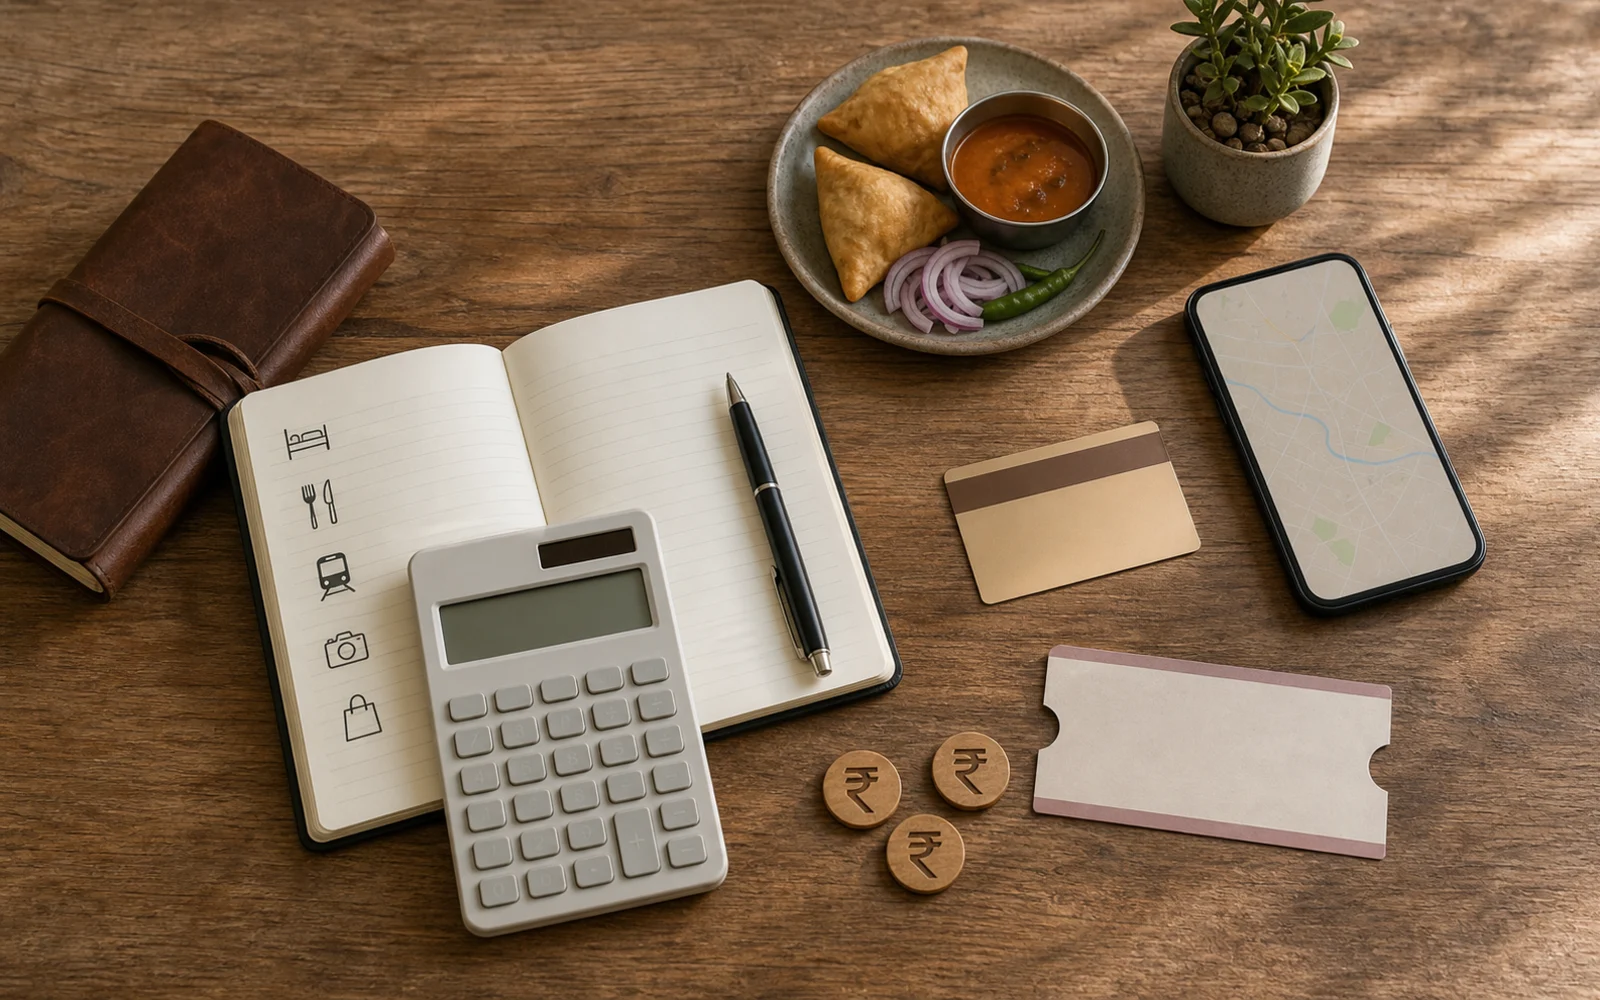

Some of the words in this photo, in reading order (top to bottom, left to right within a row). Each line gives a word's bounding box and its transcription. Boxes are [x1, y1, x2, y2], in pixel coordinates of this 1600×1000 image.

[843, 767, 879, 814] ₹
[953, 748, 988, 795] ₹
[907, 831, 942, 879] ₹
